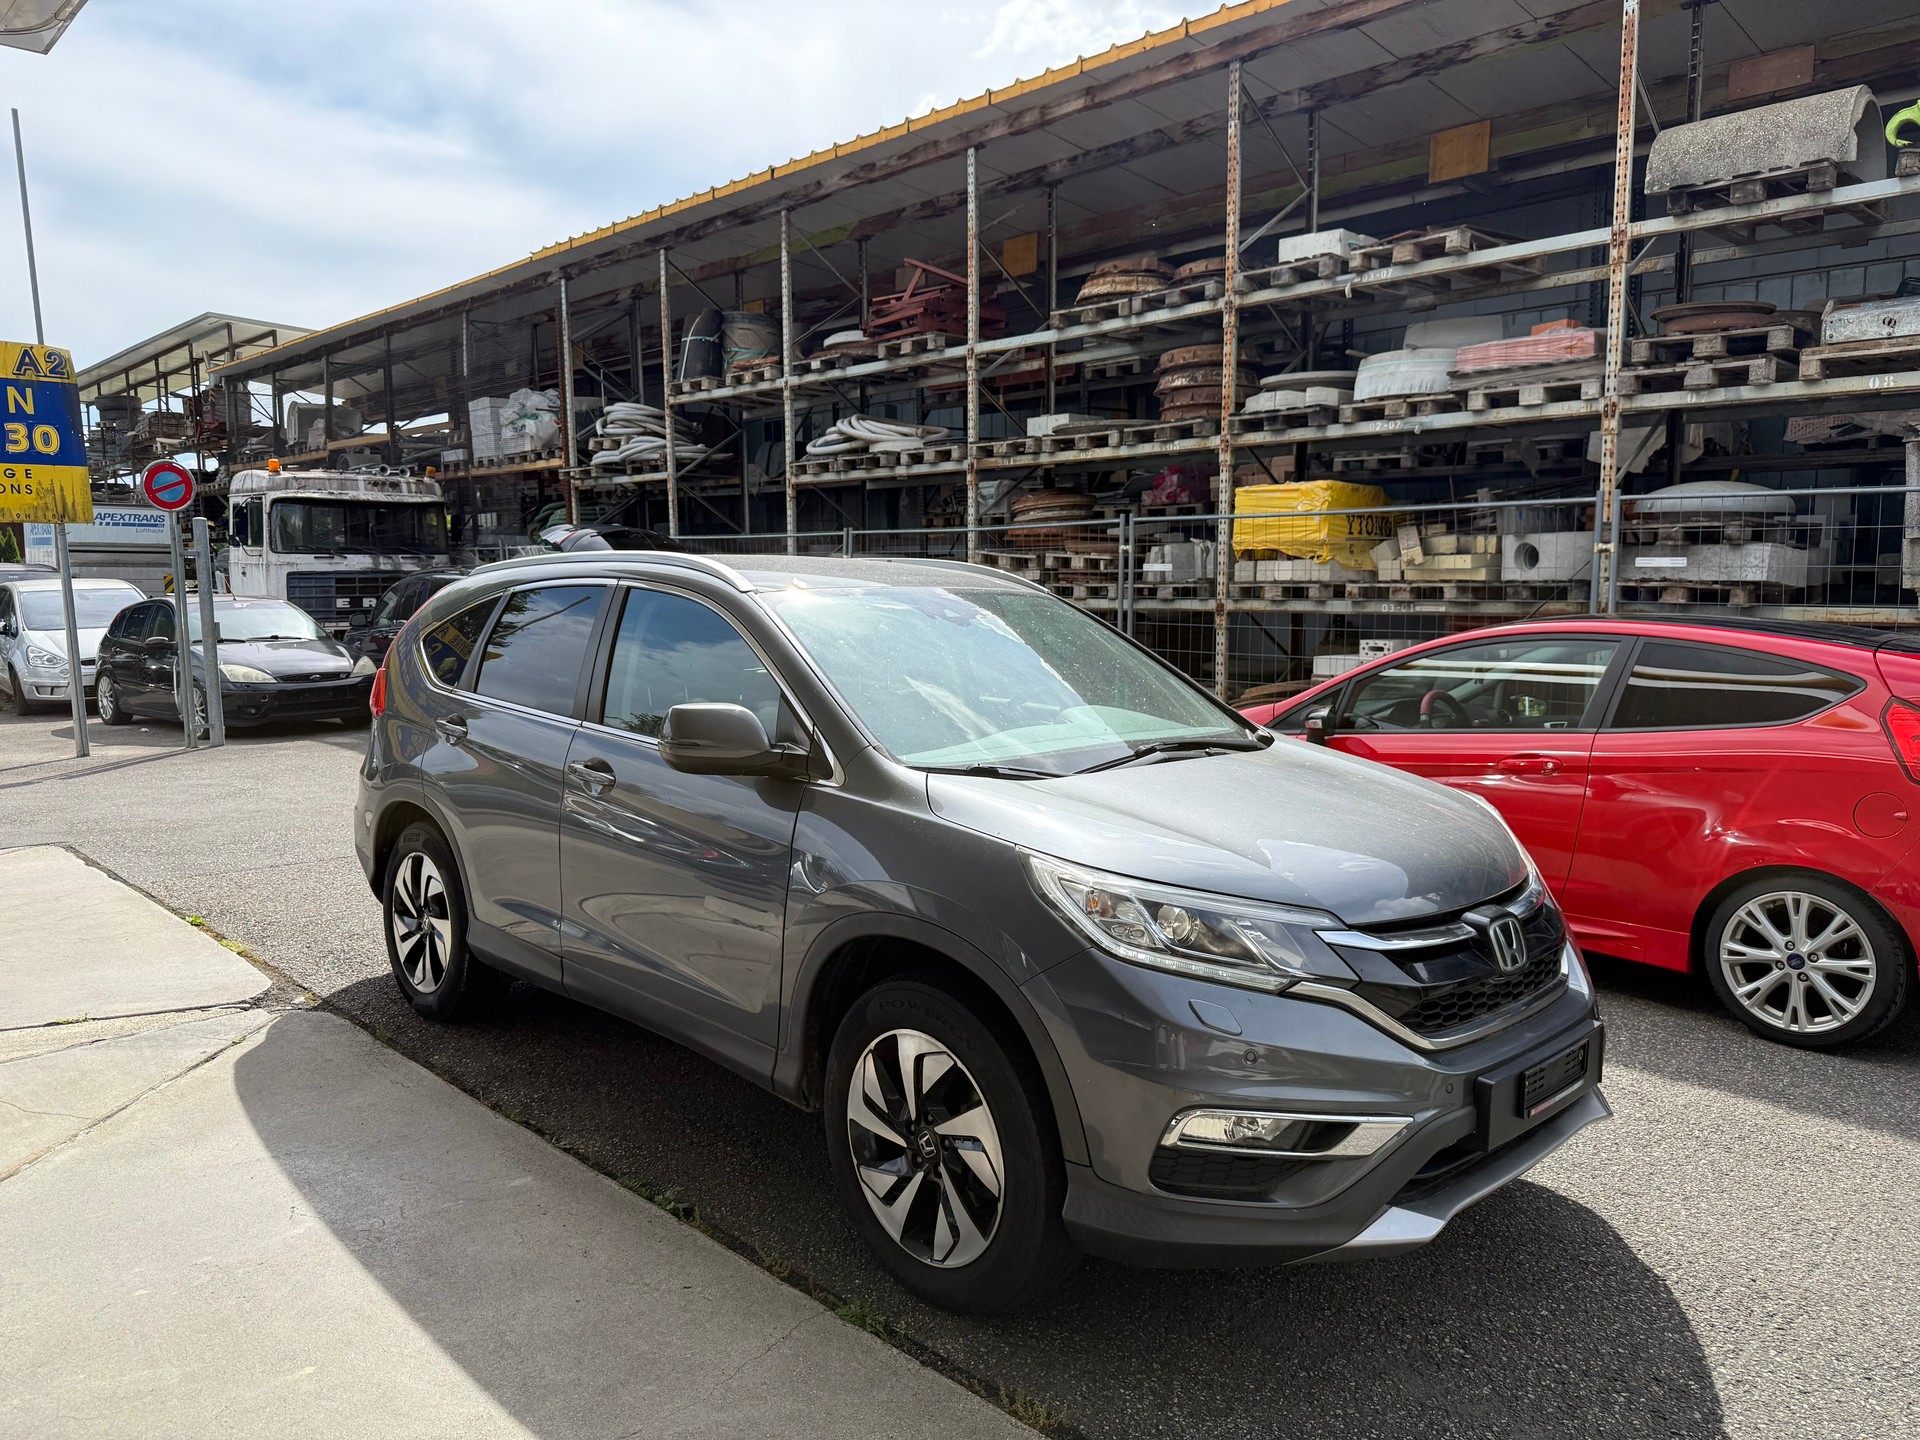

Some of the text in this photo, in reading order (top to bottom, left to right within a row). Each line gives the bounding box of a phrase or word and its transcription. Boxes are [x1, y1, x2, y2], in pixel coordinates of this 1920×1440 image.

[12, 346, 70, 380] A2
[4, 422, 60, 455] 30
[95, 512, 165, 523] APEXTRANS
[1346, 514, 1393, 537] YTONG
